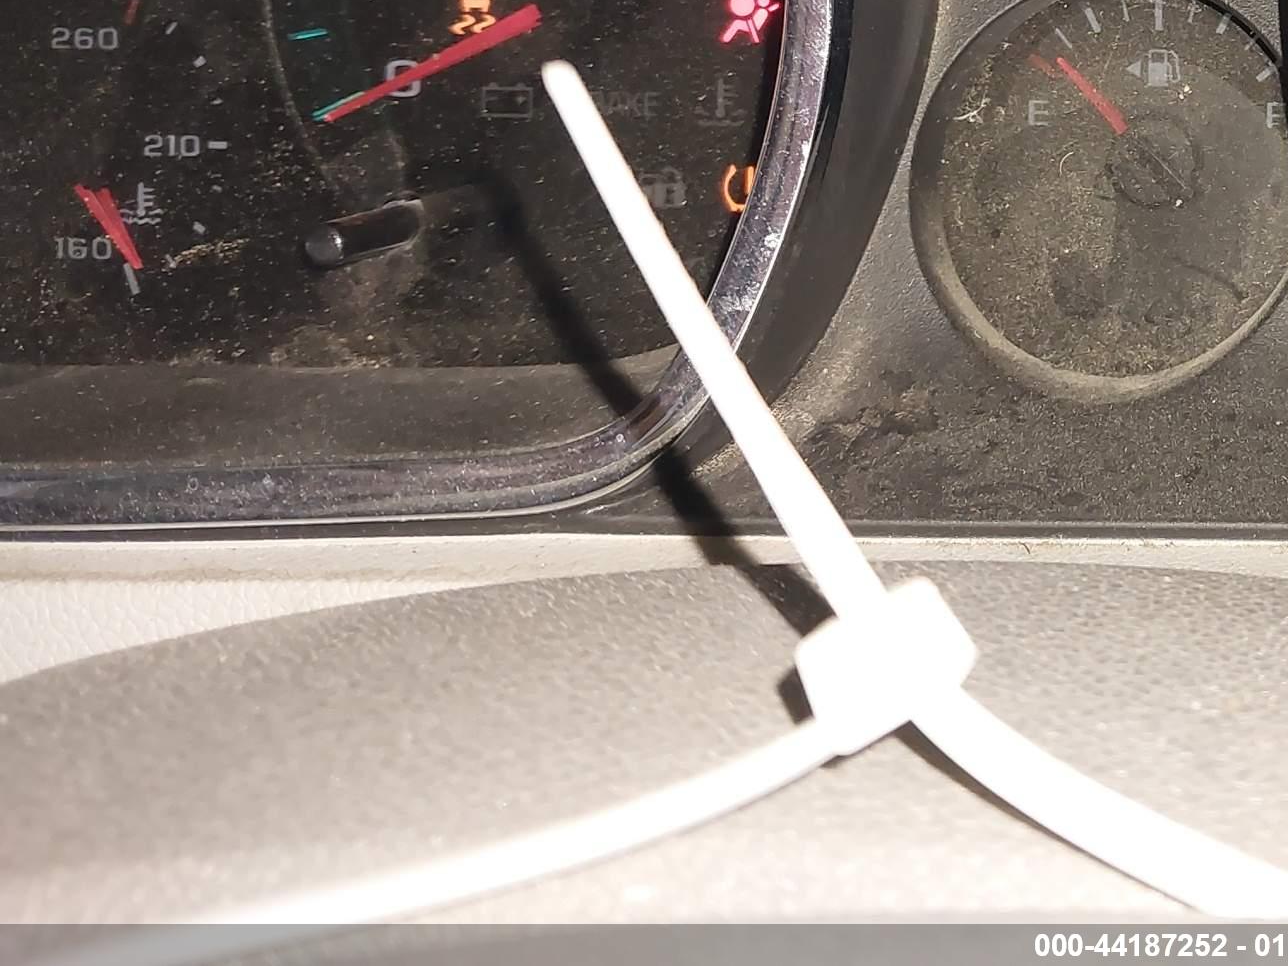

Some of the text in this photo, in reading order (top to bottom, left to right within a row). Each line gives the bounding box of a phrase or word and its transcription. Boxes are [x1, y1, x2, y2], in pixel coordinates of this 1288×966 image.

[50, 27, 120, 51] 260
[1028, 100, 1049, 127] E
[143, 134, 201, 158] 210
[55, 236, 113, 261] 160
